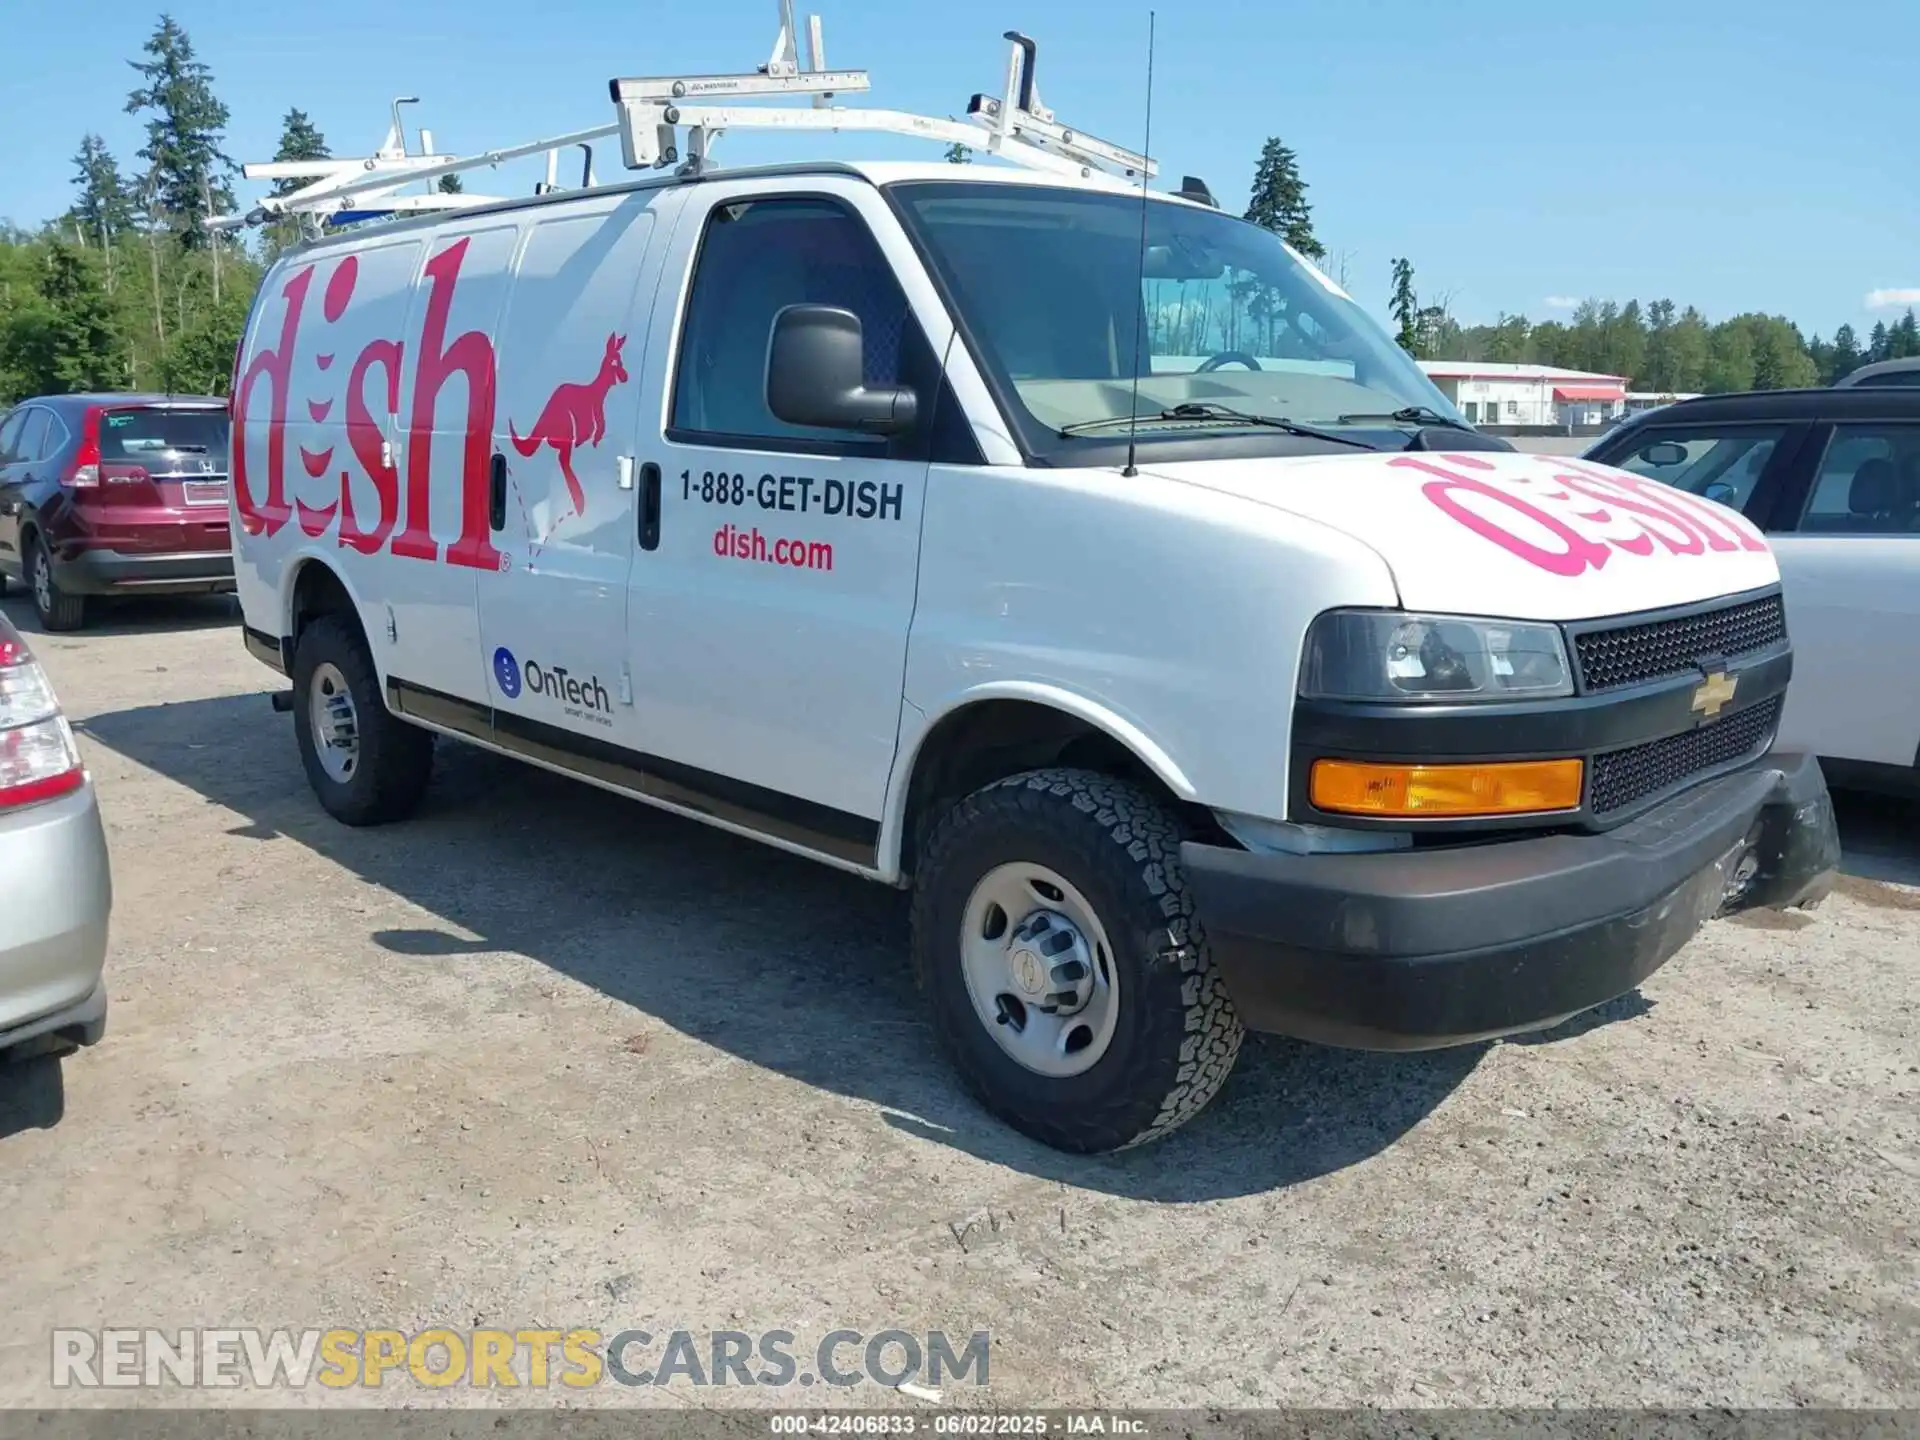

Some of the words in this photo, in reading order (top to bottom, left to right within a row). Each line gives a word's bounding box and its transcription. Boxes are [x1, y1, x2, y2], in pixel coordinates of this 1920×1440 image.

[234, 237, 501, 572] dish
[680, 469, 904, 521] 1-888-GET-DISH
[1386, 454, 1769, 577] dish
[714, 524, 833, 570] dish.com
[525, 660, 610, 713] OnTech
